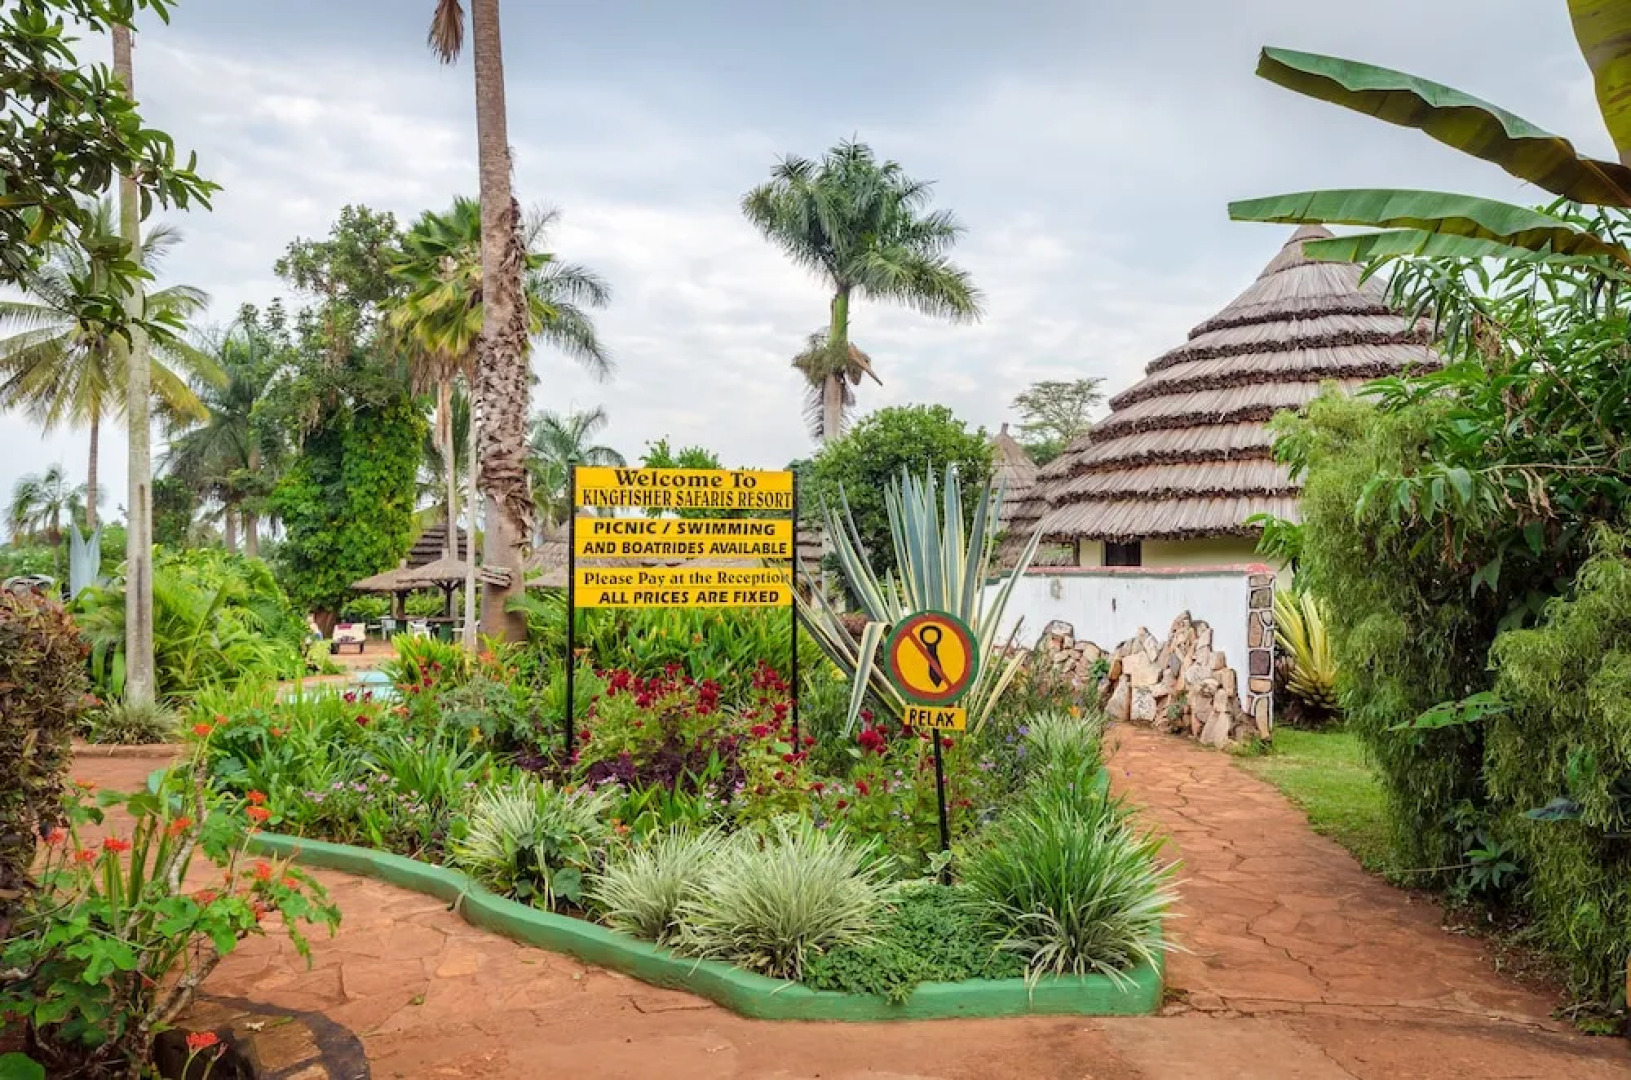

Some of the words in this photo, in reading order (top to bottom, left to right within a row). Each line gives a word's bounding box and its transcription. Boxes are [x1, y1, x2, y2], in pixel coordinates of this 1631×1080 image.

[614, 469, 722, 487] Welcome
[730, 472, 758, 489] To
[582, 489, 672, 506] KINGFISHER
[676, 490, 734, 507] SAFARIS
[738, 492, 792, 508] RESORT
[594, 522, 656, 534] PICNIC
[663, 522, 671, 534] /
[676, 522, 776, 536] SWIMMING
[582, 542, 616, 554] AND
[622, 542, 704, 554] BOATRIDES
[709, 542, 787, 554] AVAILABLE
[584, 572, 633, 585] Please
[639, 572, 665, 588] Pay
[670, 573, 684, 585] at
[689, 571, 712, 585] the
[598, 591, 628, 604] ALL
[634, 591, 690, 604] PRICES
[696, 591, 728, 603] ARE
[733, 591, 779, 603] FIXED
[909, 707, 955, 727] RELAX
